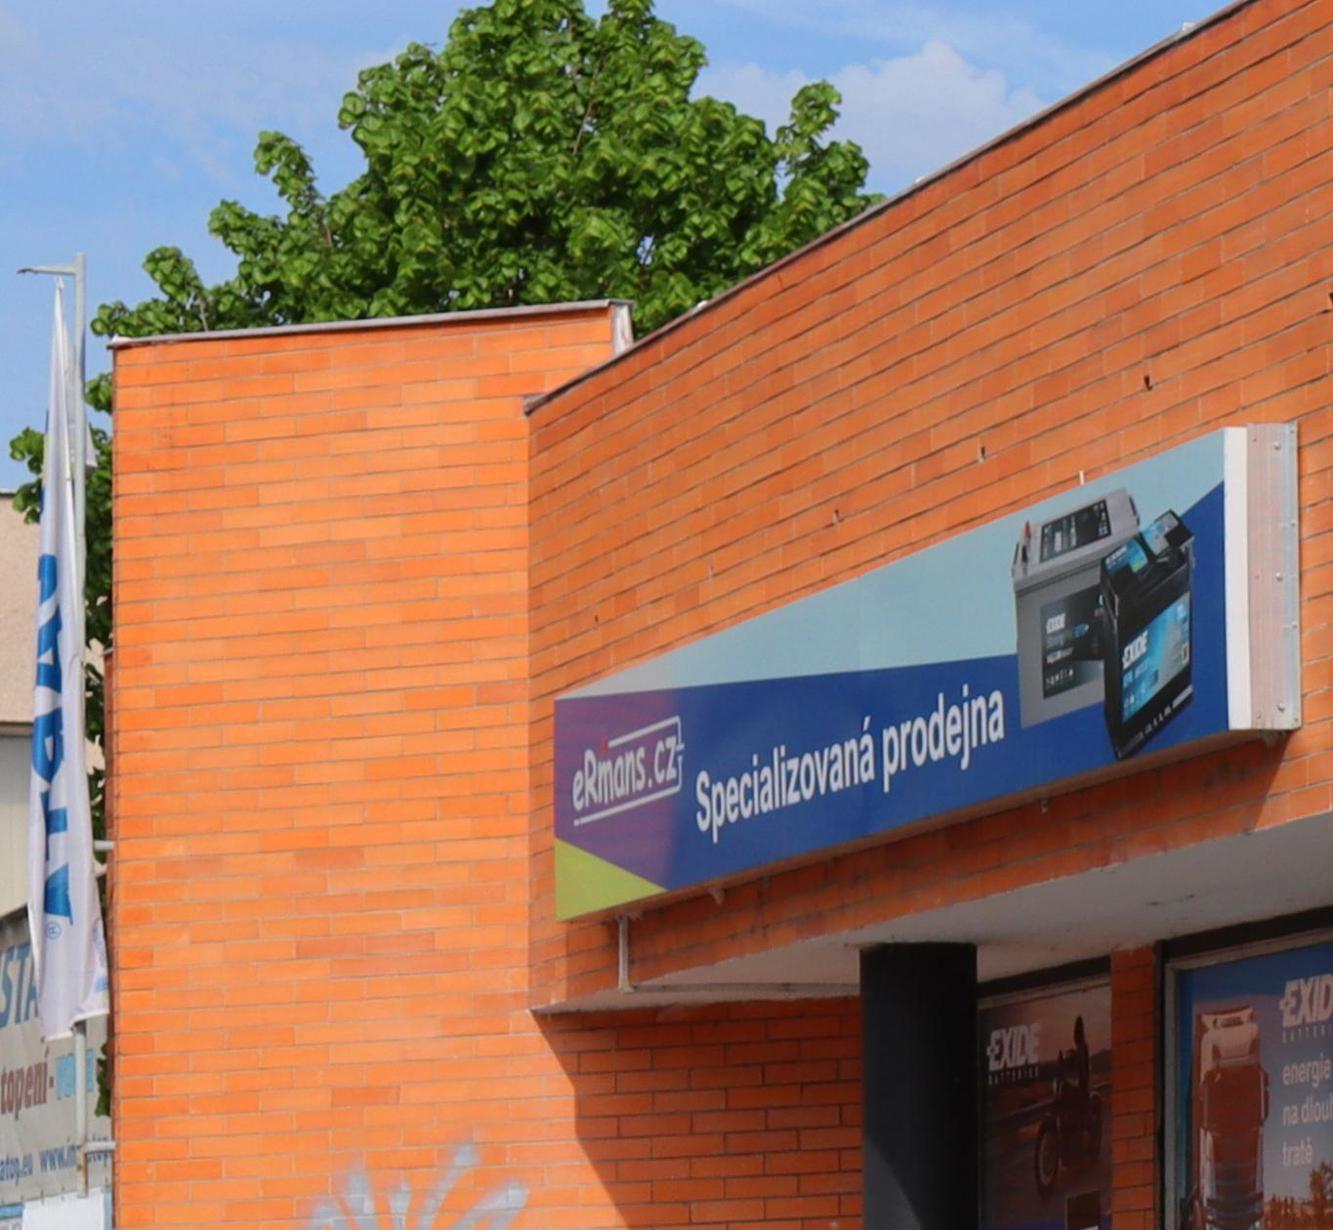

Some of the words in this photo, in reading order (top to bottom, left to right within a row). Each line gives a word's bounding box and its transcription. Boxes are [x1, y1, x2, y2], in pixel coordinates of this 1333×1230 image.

[572, 736, 677, 811] eRmans.cz
[696, 716, 875, 843] Specializovaná
[883, 684, 1004, 793] prodejna
[986, 1022, 1041, 1071] EXIDE
[1282, 1051, 1332, 1088] energie
[1282, 1103, 1299, 1127] na
